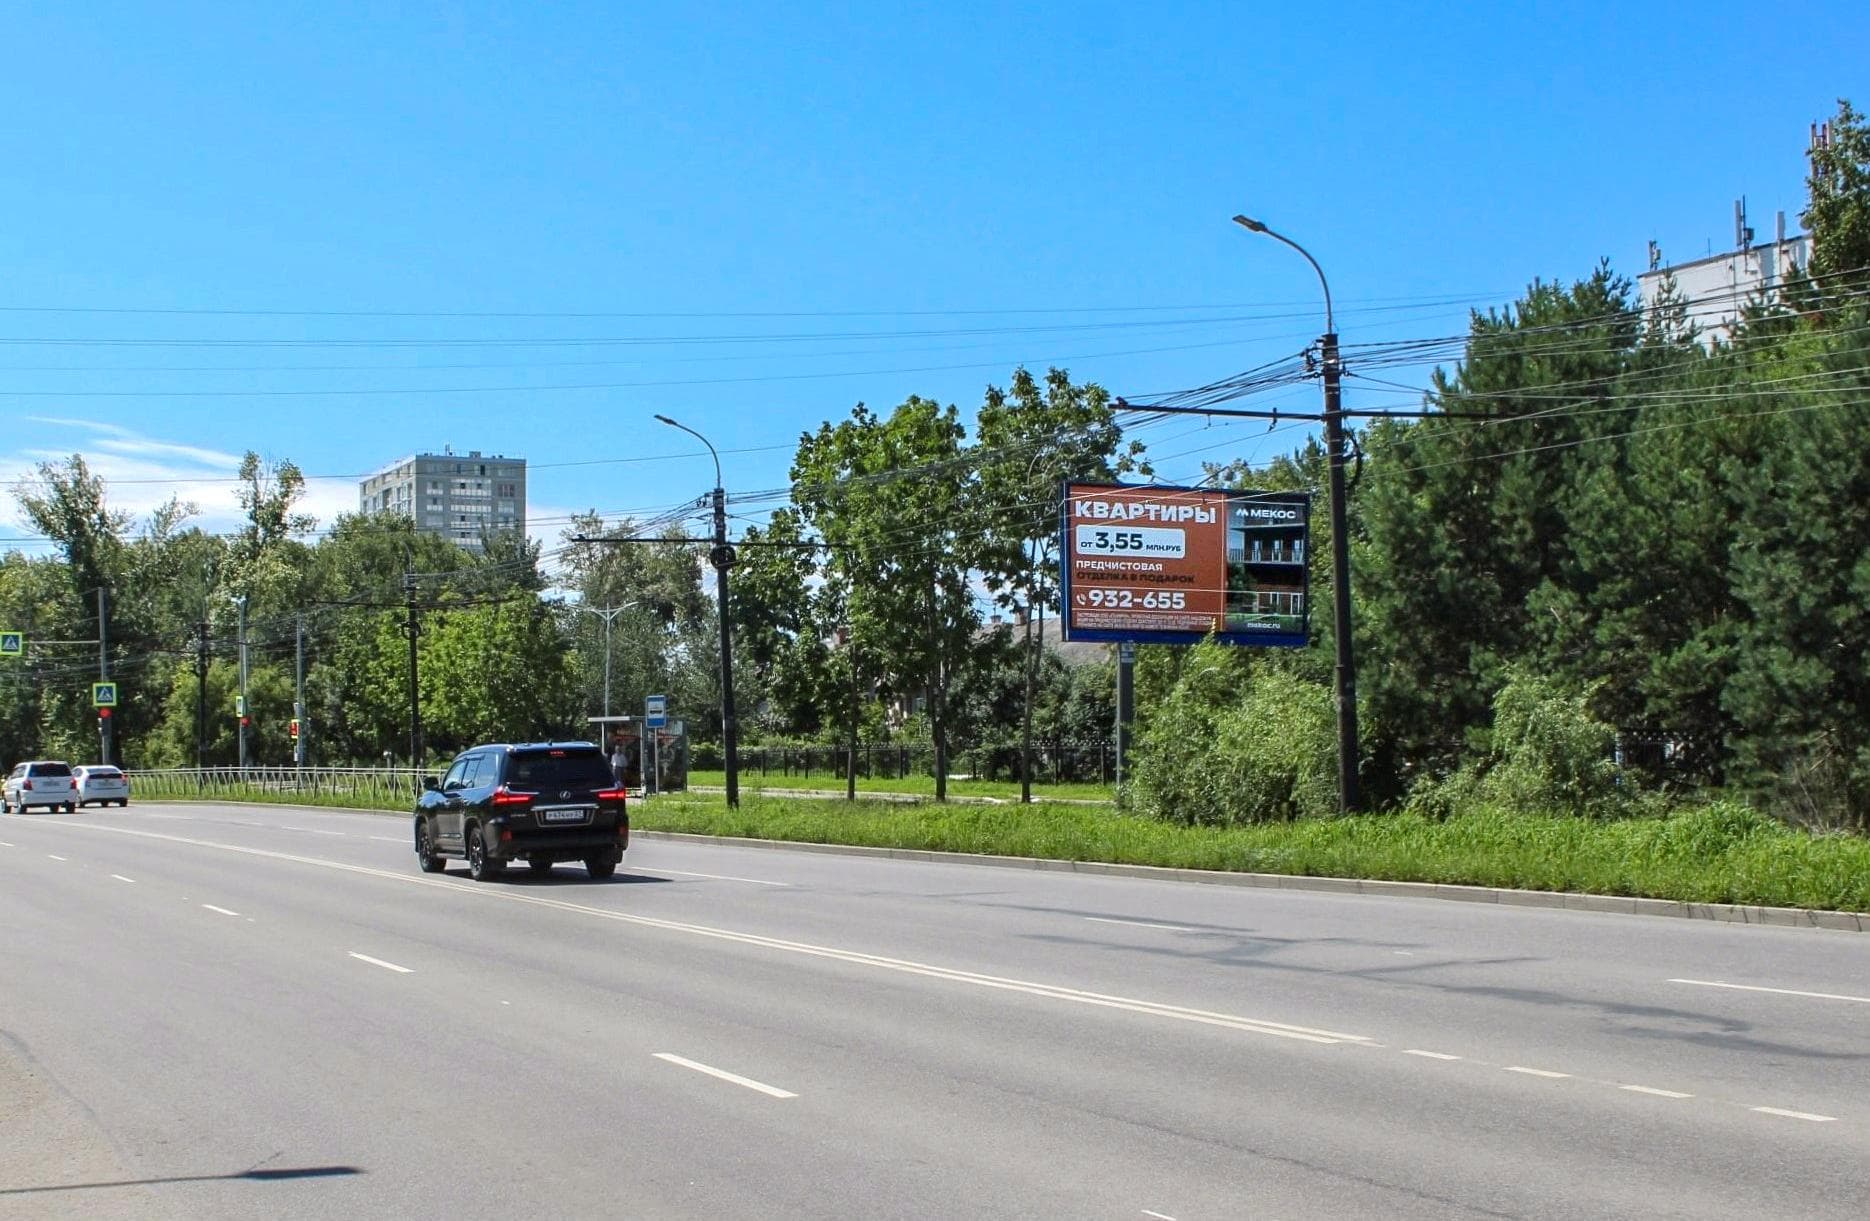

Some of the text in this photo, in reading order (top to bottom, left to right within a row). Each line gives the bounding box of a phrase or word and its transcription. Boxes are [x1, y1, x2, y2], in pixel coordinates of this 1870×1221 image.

[1075, 500, 1216, 524] КВАРТИРЫ
[1250, 509, 1296, 519] МЕКОС
[1095, 532, 1143, 552] 3,55
[1076, 560, 1163, 571] ПРЕДЧИСТОВАЯ
[1076, 571, 1195, 583] ОТДЕЛКА В ПОДАРОК
[1088, 589, 1186, 609] 932-655
